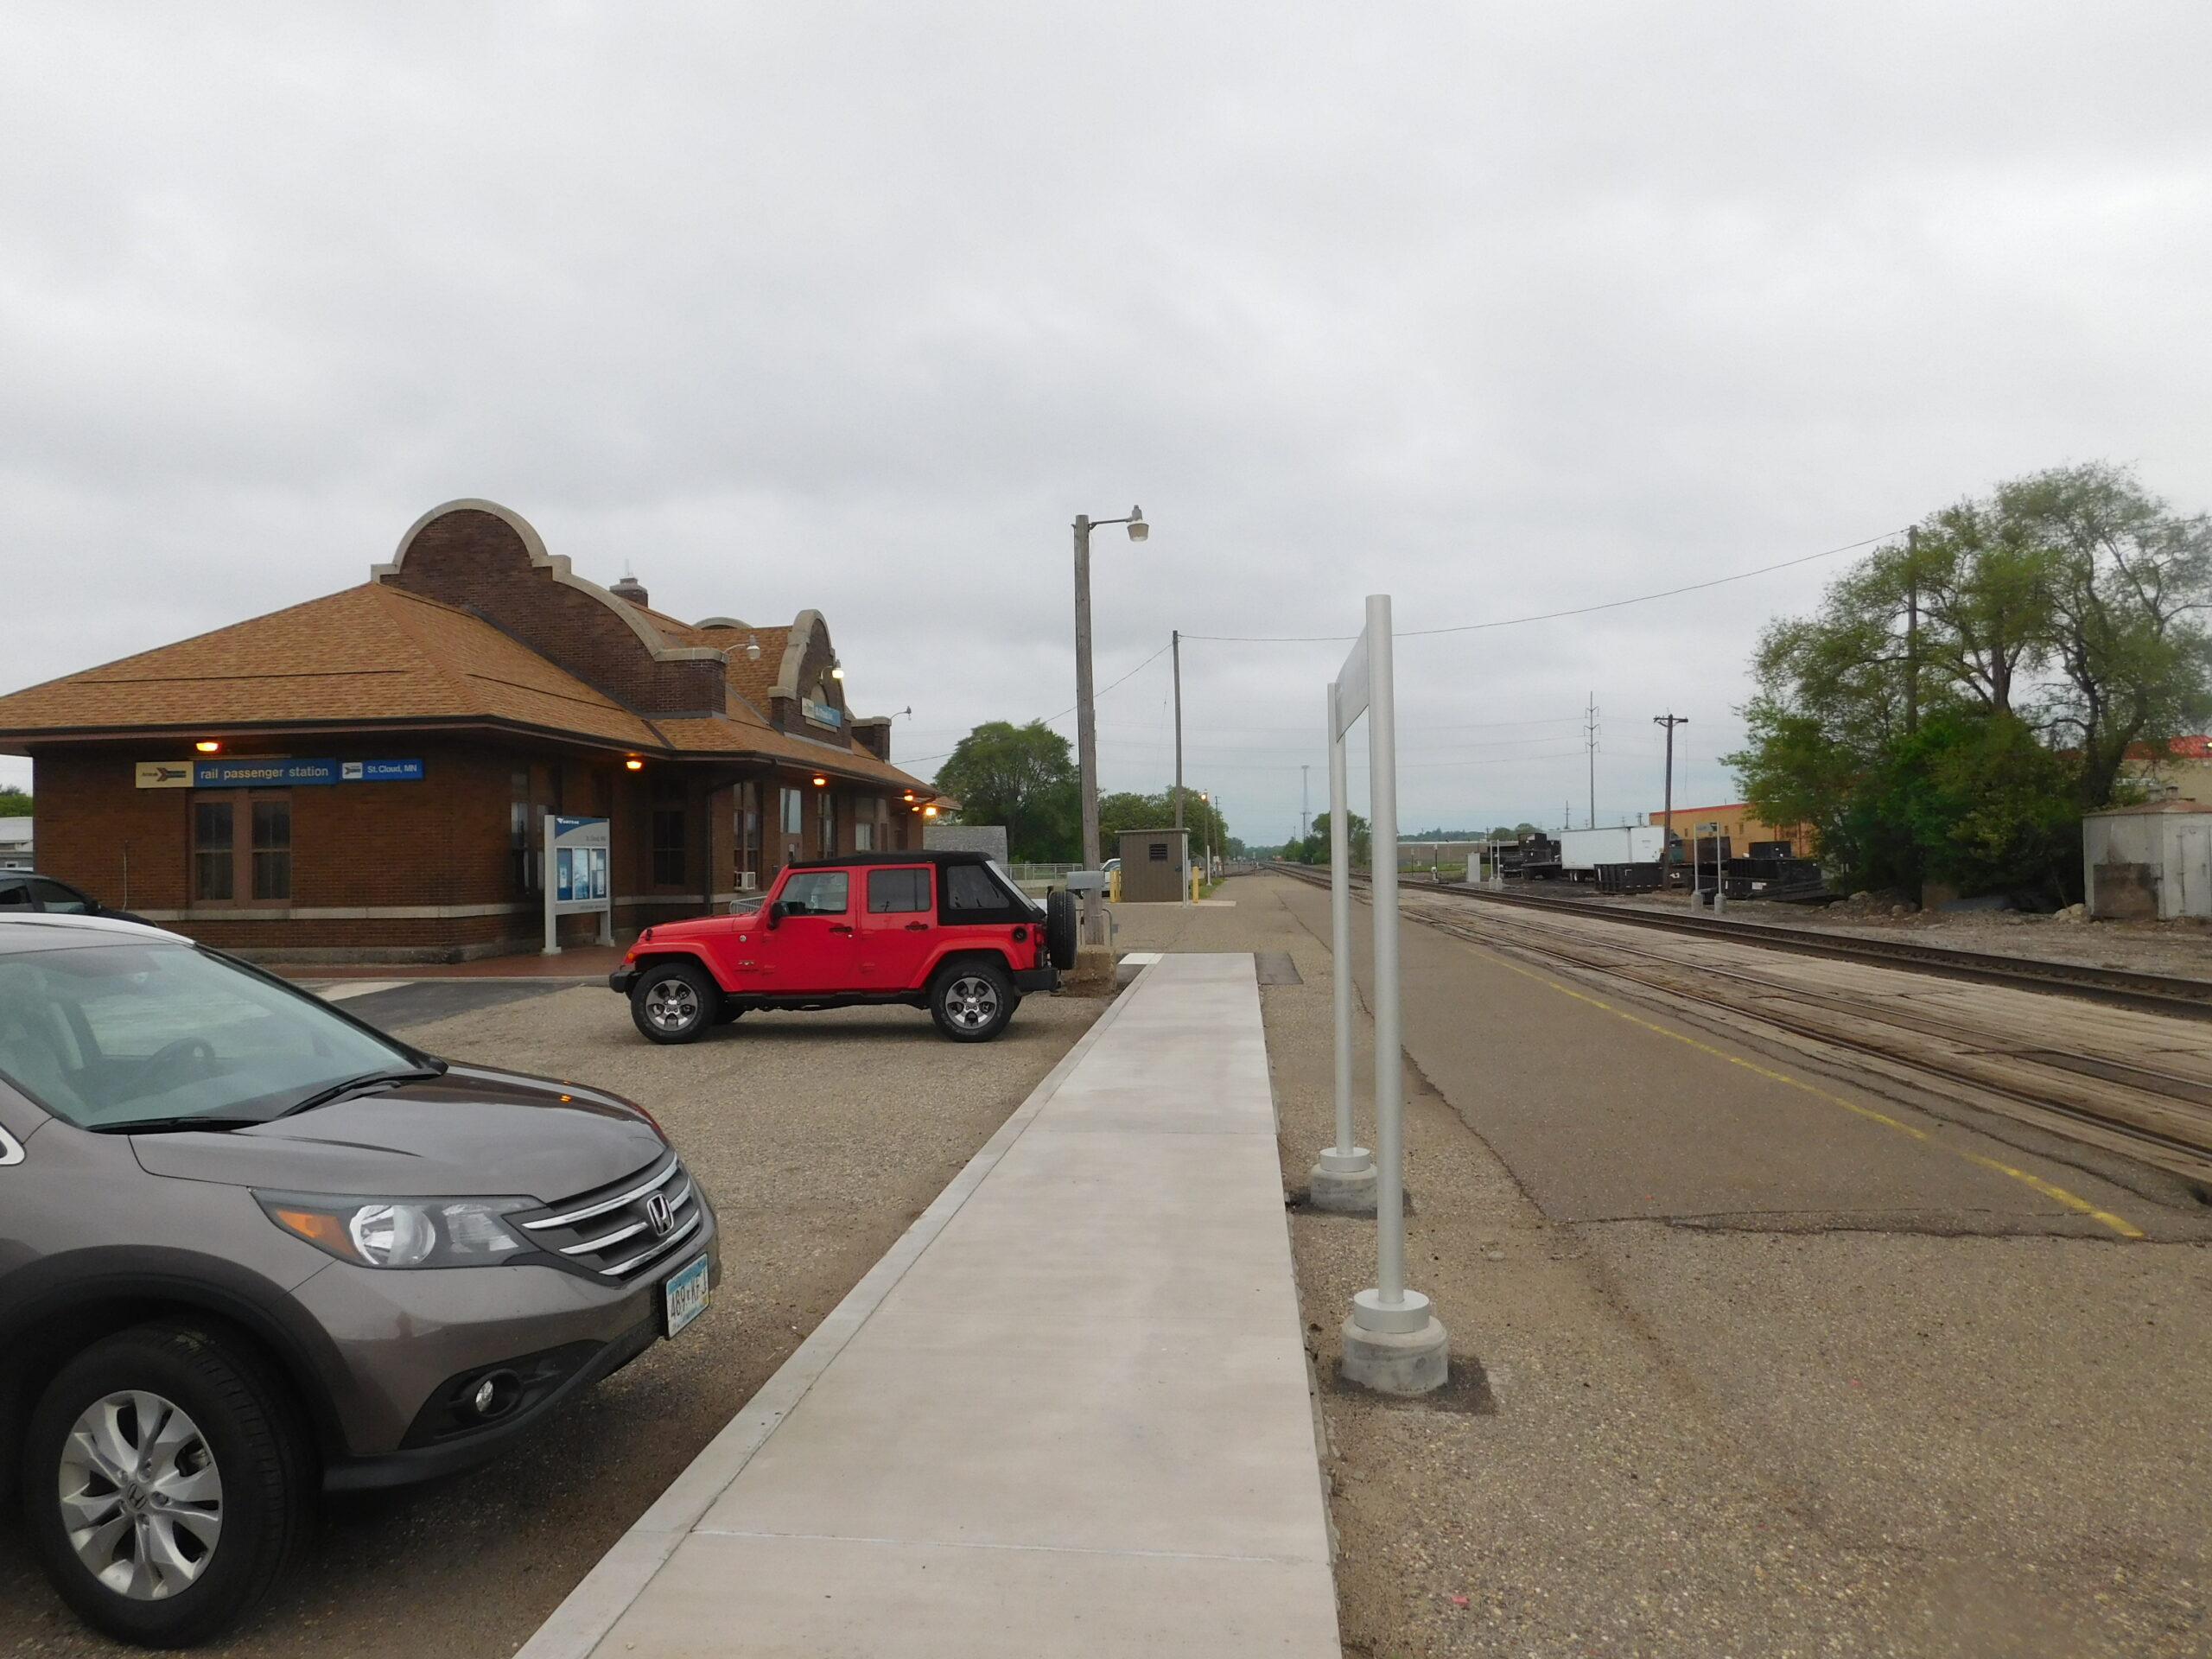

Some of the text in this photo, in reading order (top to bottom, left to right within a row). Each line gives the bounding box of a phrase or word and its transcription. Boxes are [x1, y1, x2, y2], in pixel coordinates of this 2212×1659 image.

[200, 766, 329, 780] rail passenger station
[404, 764, 417, 772] MN
